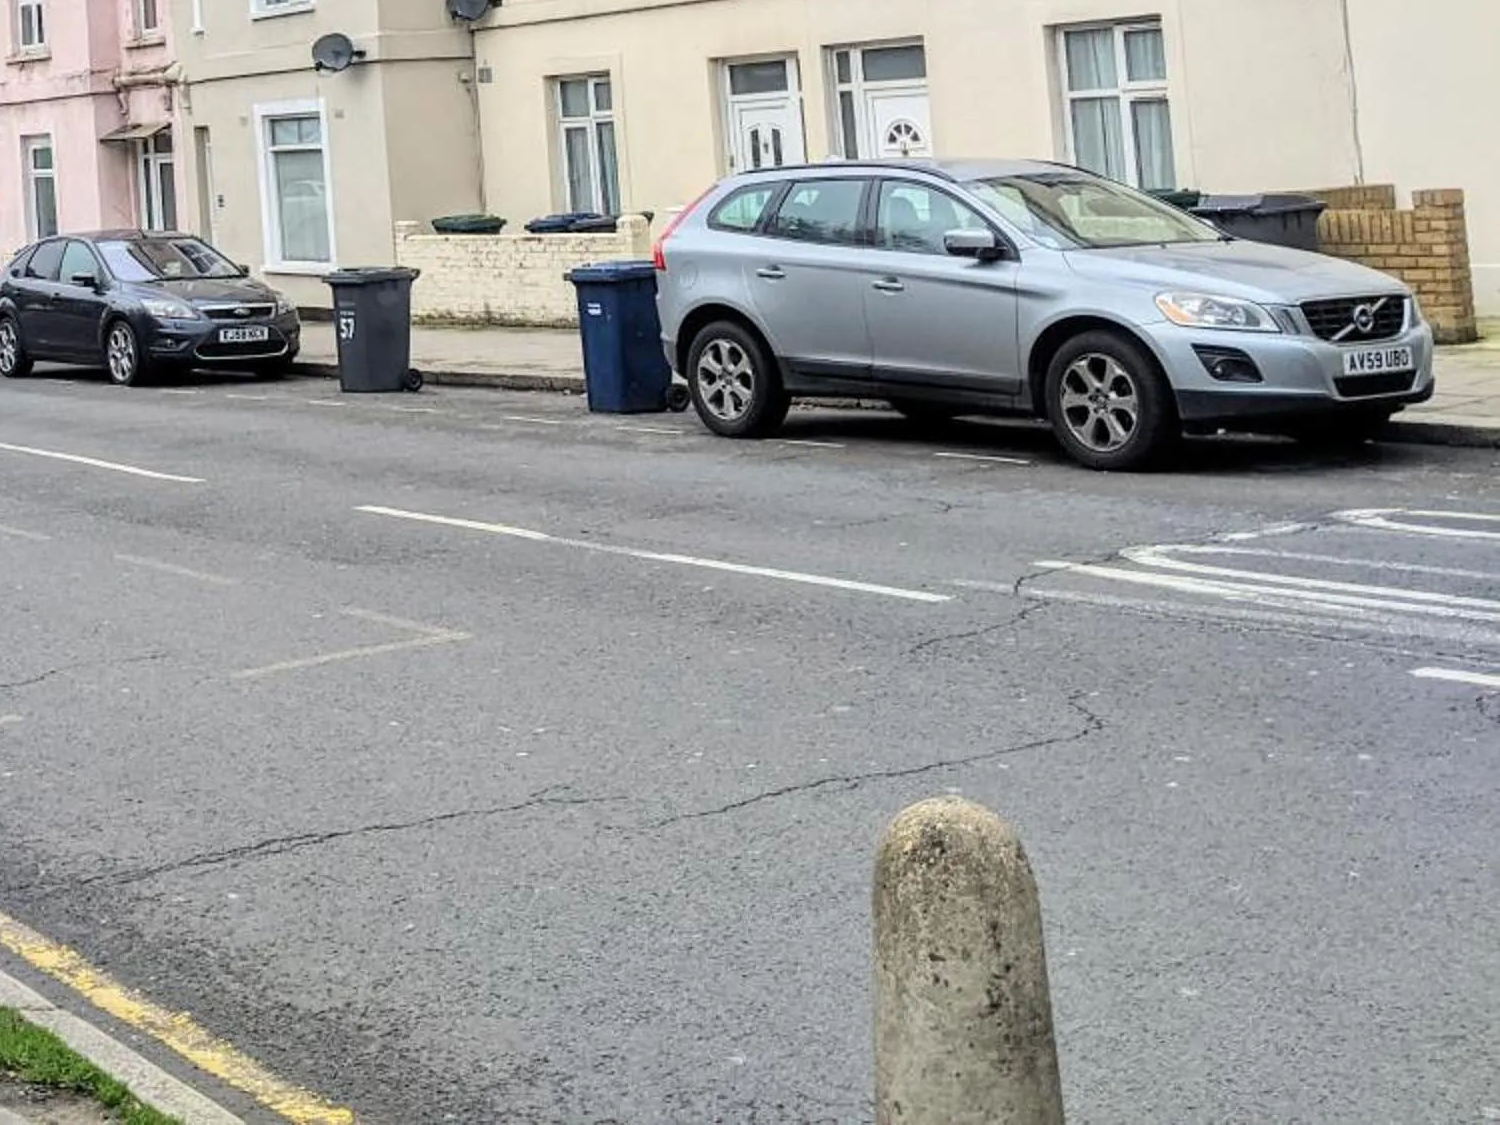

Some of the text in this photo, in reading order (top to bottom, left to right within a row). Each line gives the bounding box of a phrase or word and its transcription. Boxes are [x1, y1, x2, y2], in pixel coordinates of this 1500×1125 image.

[340, 317, 355, 339] 57
[1349, 348, 1409, 372] AV59 UBO
